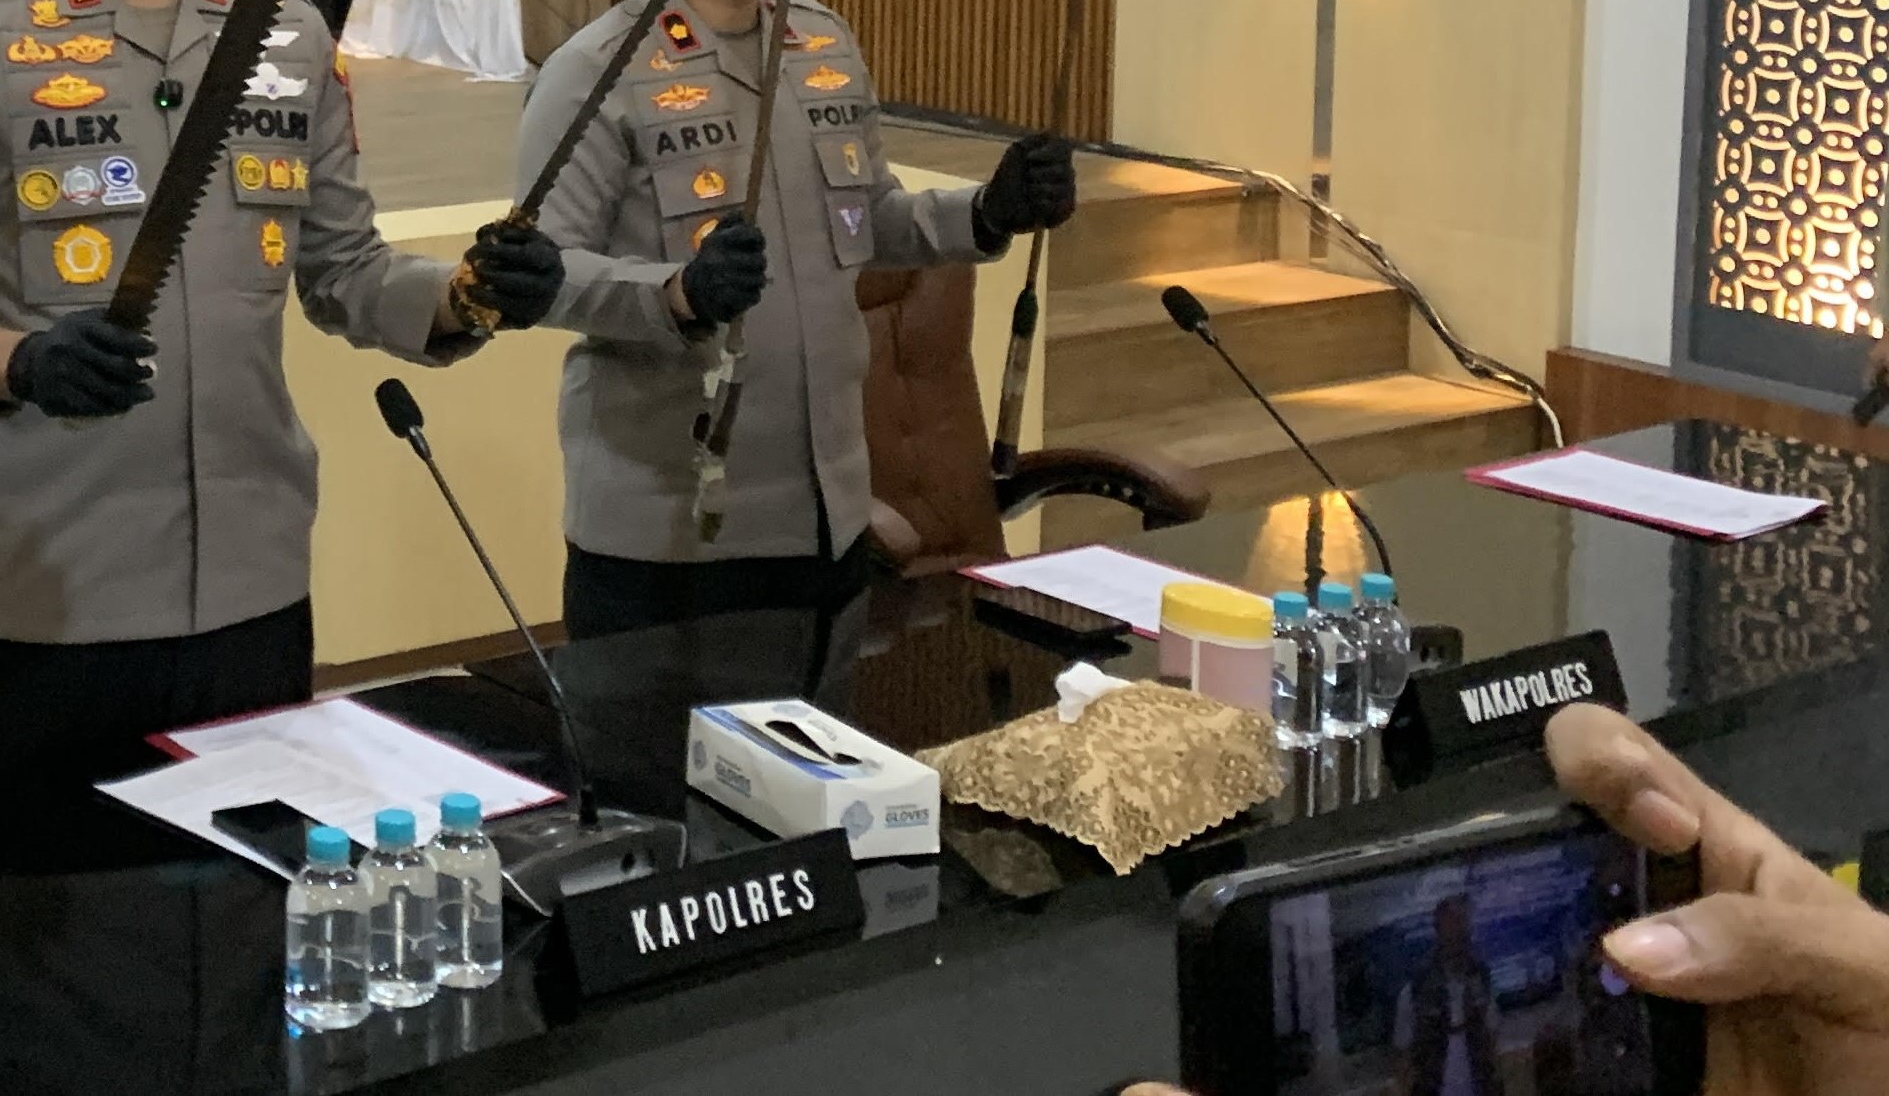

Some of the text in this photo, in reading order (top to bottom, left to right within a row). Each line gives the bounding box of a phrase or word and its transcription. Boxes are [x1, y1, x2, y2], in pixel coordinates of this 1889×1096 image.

[28, 113, 122, 151] ALEX
[656, 119, 737, 155] ARDI
[1458, 661, 1595, 725] WAKAPOLRES
[631, 866, 818, 955] KAPOLRES
